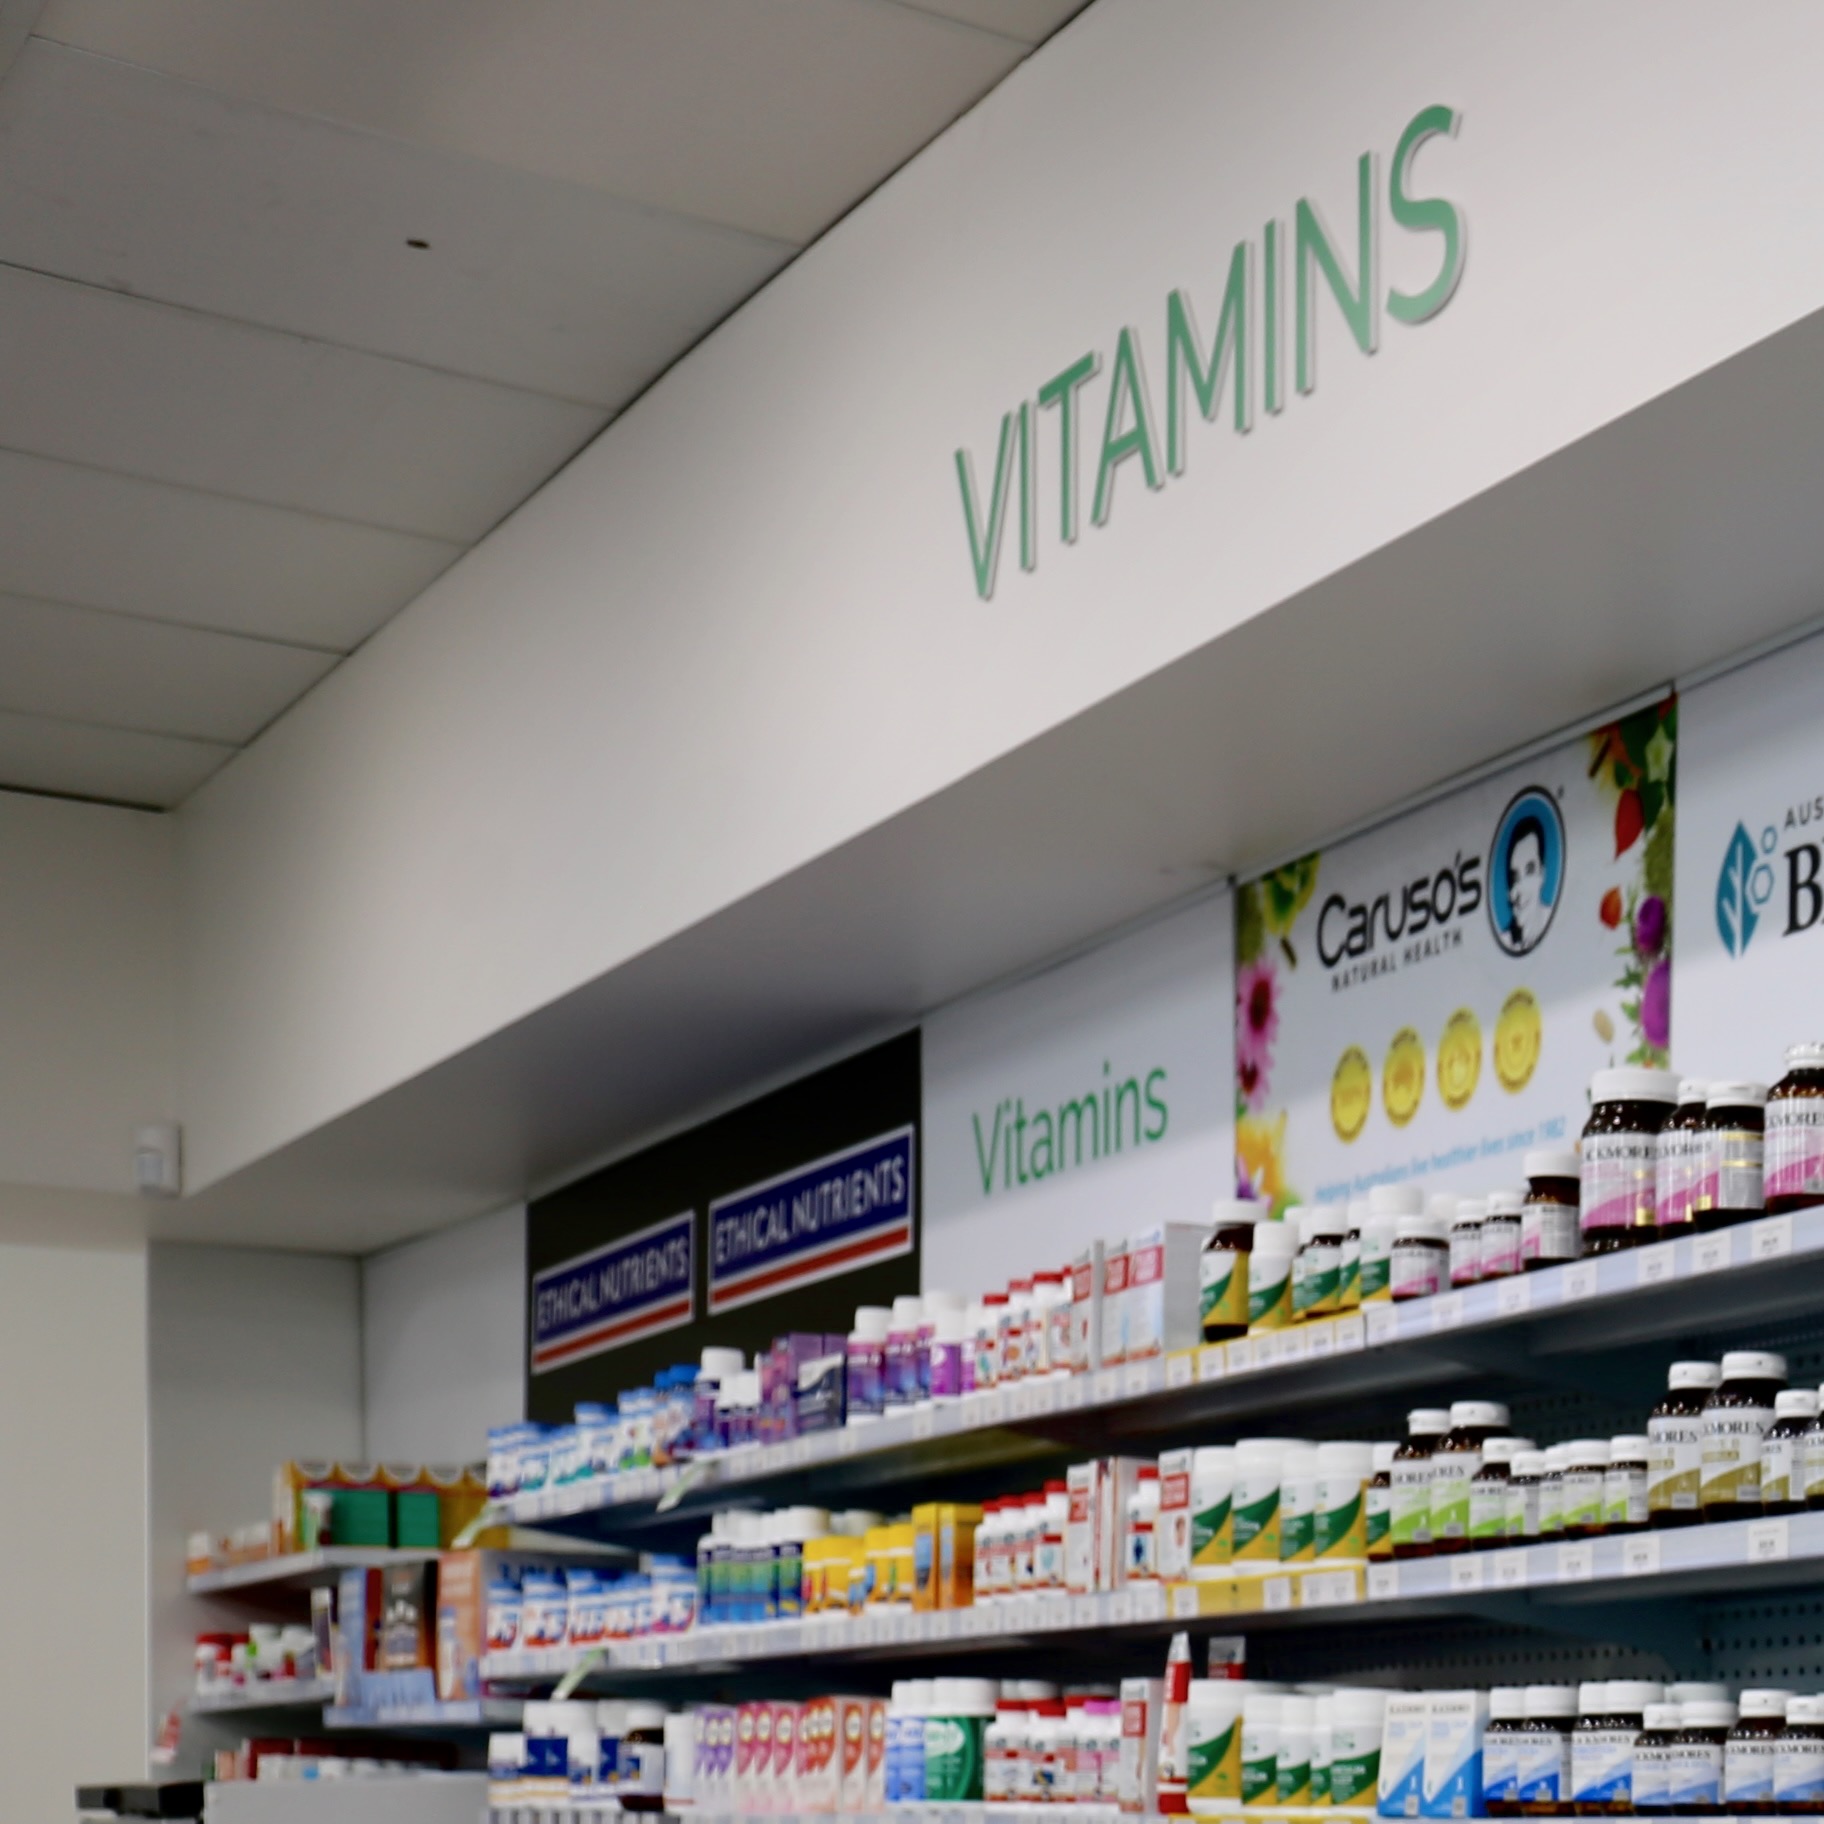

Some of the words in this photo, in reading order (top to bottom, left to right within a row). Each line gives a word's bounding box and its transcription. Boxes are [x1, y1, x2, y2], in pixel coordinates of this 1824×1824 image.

[954, 104, 1467, 601] VITAMINS
[1331, 950, 1399, 992] NATURAL
[1404, 929, 1462, 964] HEALTH
[971, 1059, 1169, 1195] Vitamins
[712, 1192, 789, 1267] ETHICAL
[791, 1151, 906, 1232] NUTRIENTS
[534, 1275, 597, 1335] ETHICAL
[599, 1234, 692, 1311] NUTRIENTS
